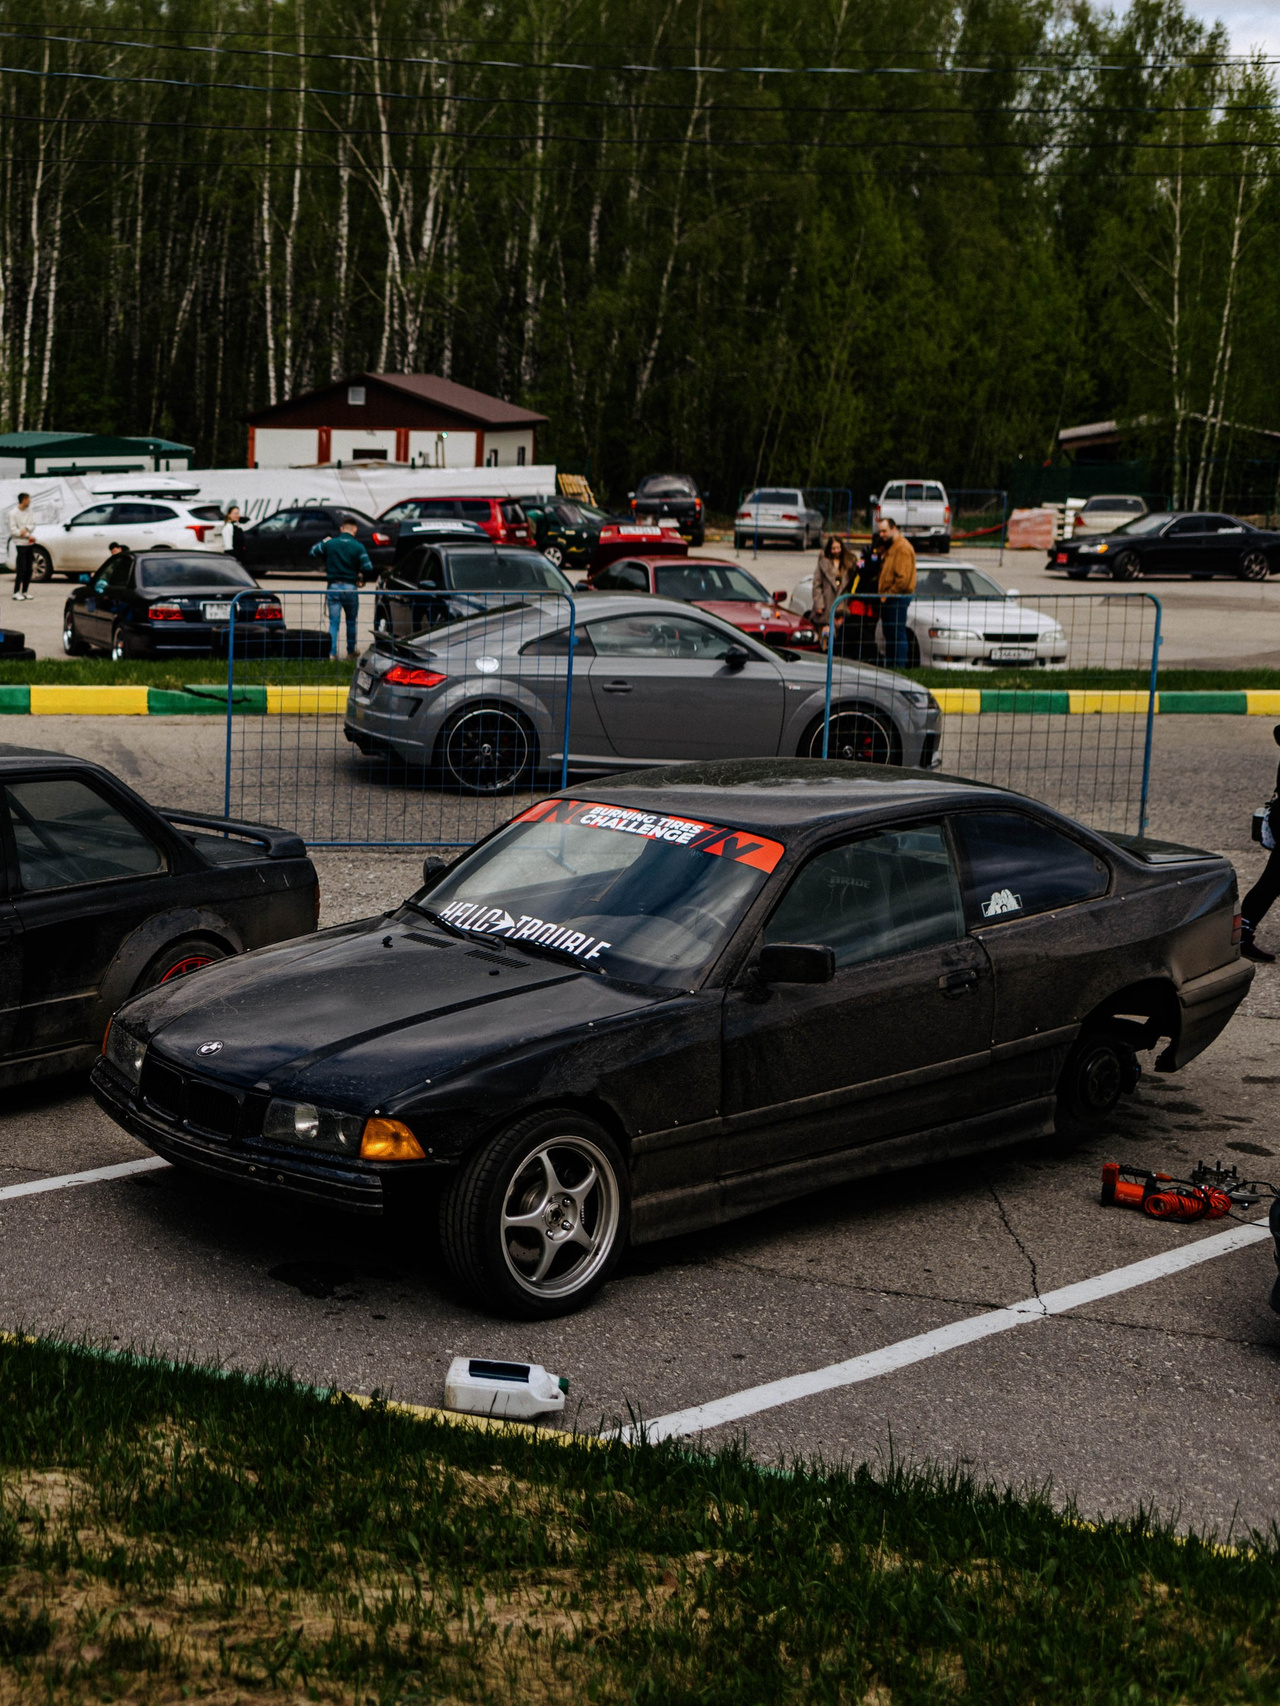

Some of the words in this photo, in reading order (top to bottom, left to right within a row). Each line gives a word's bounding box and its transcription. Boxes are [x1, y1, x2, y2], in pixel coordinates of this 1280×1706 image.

[579, 814, 697, 845] CHALLENGE
[588, 806, 658, 824] BURNING
[657, 817, 704, 835] TIRES
